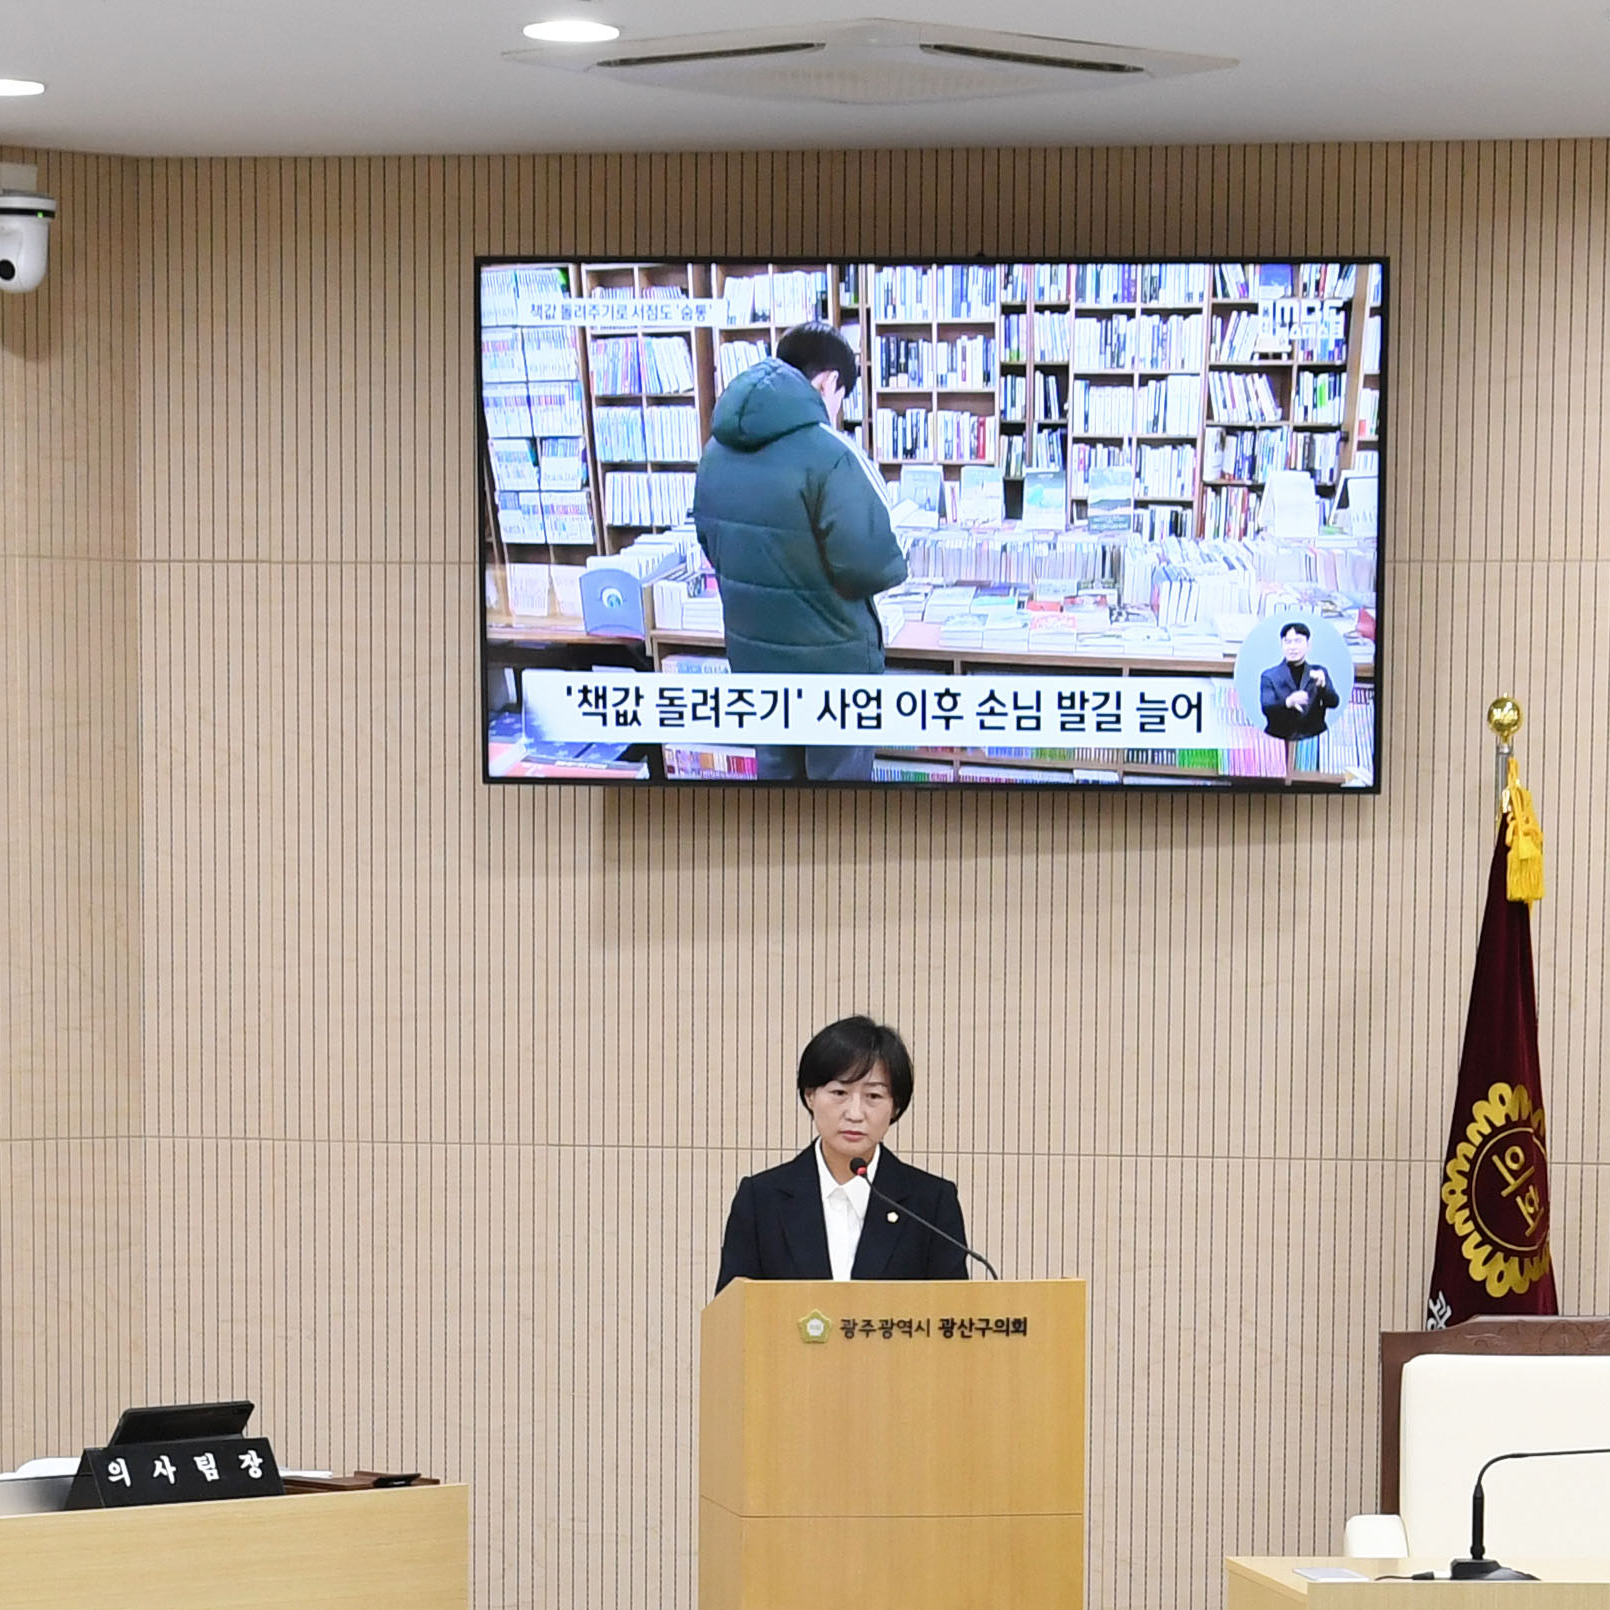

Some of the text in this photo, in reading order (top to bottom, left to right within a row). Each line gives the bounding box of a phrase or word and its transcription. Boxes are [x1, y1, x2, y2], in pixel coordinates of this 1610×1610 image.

[566, 684, 1203, 734] '책값 돌려주기' 사업 이후 손님 발길 늘어
[839, 1316, 1029, 1340] 광주광역시 광산구의회
[107, 1449, 264, 1488] 의사팀장
